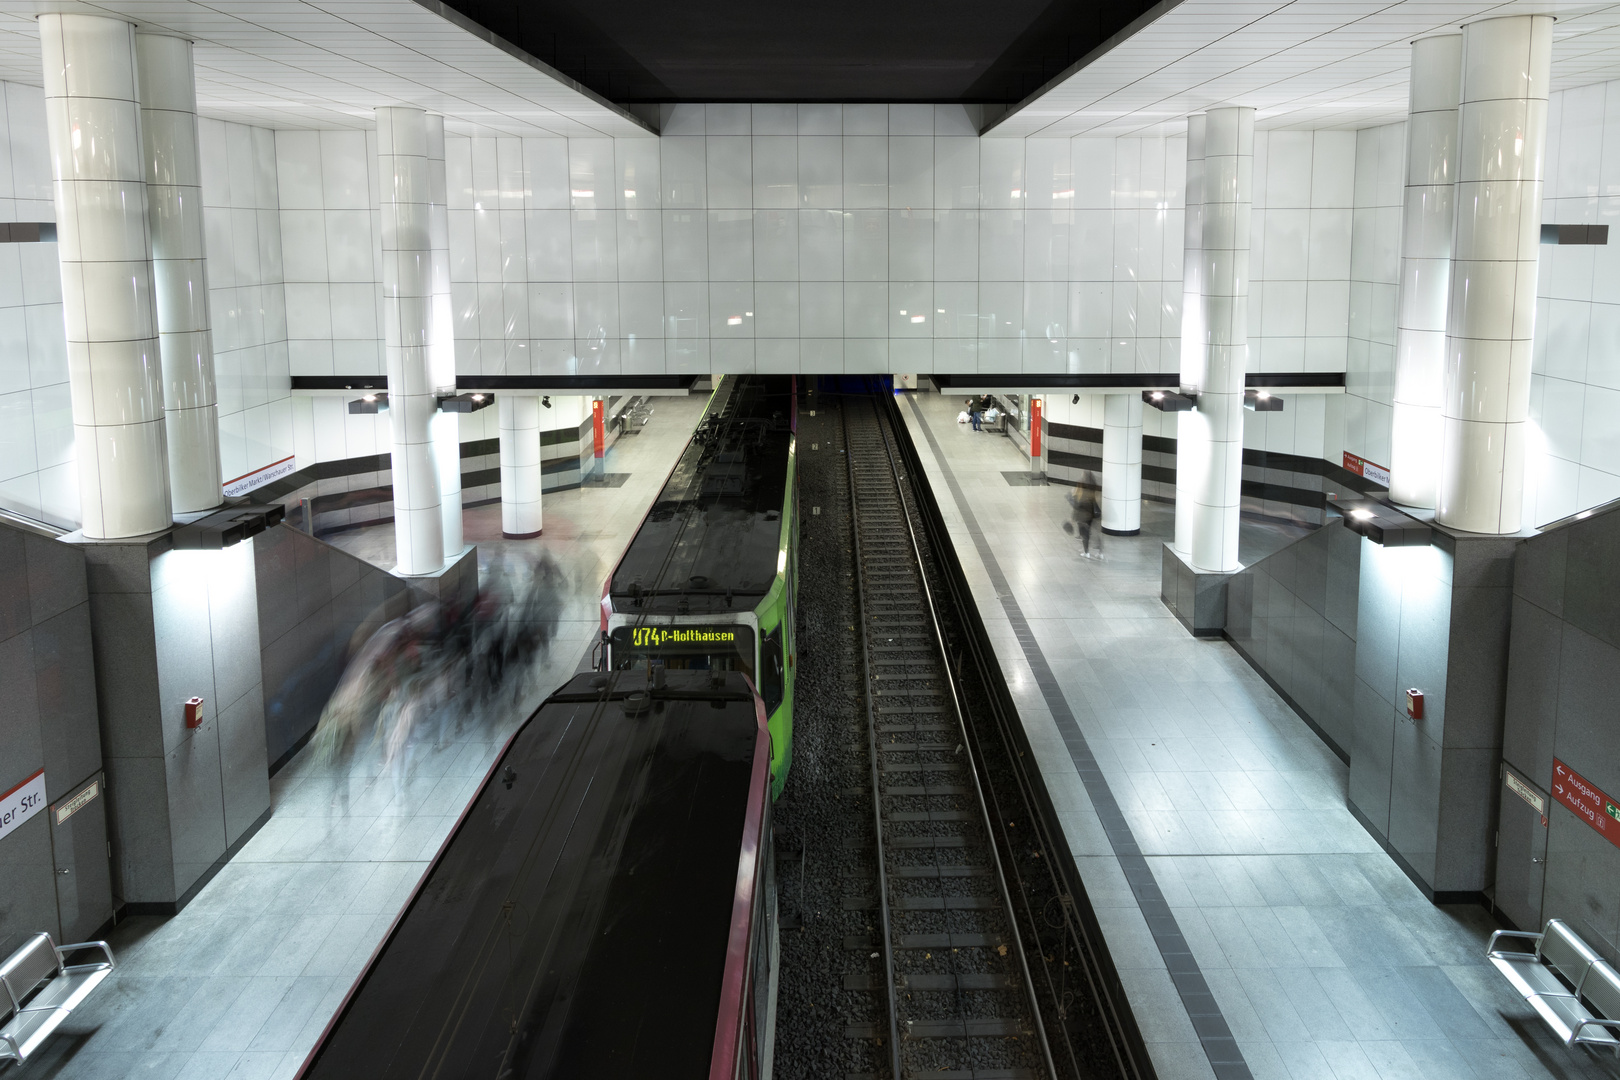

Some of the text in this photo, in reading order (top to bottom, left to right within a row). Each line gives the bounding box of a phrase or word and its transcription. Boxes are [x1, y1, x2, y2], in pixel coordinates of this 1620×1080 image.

[633, 628, 660, 646] U74
[1568, 774, 1600, 806] Ausgang
[20, 792, 41, 813] Str.
[1566, 792, 1594, 820] Aufzug
